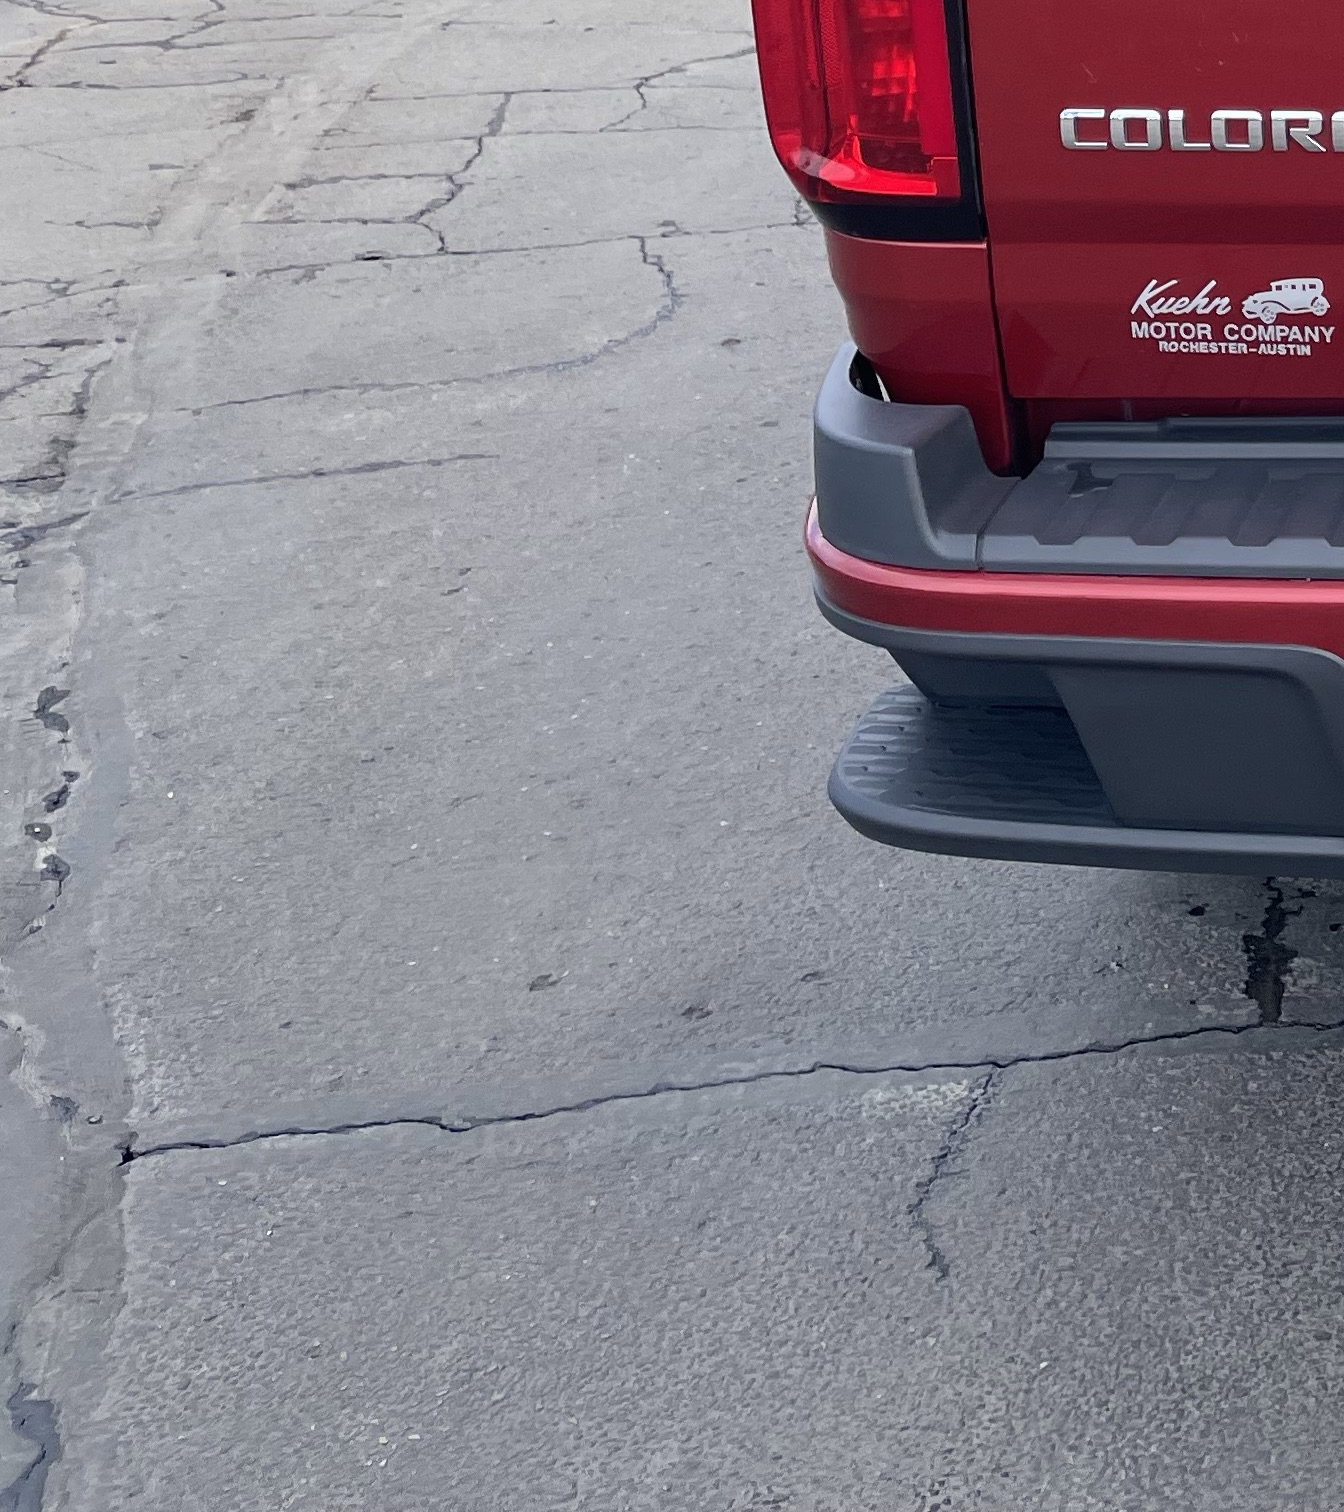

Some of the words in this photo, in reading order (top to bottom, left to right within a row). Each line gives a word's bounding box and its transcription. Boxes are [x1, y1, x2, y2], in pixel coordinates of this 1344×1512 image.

[1130, 279, 1232, 319] Kuehn
[1130, 321, 1213, 341] MOTOR
[1223, 322, 1336, 344] COMPANY
